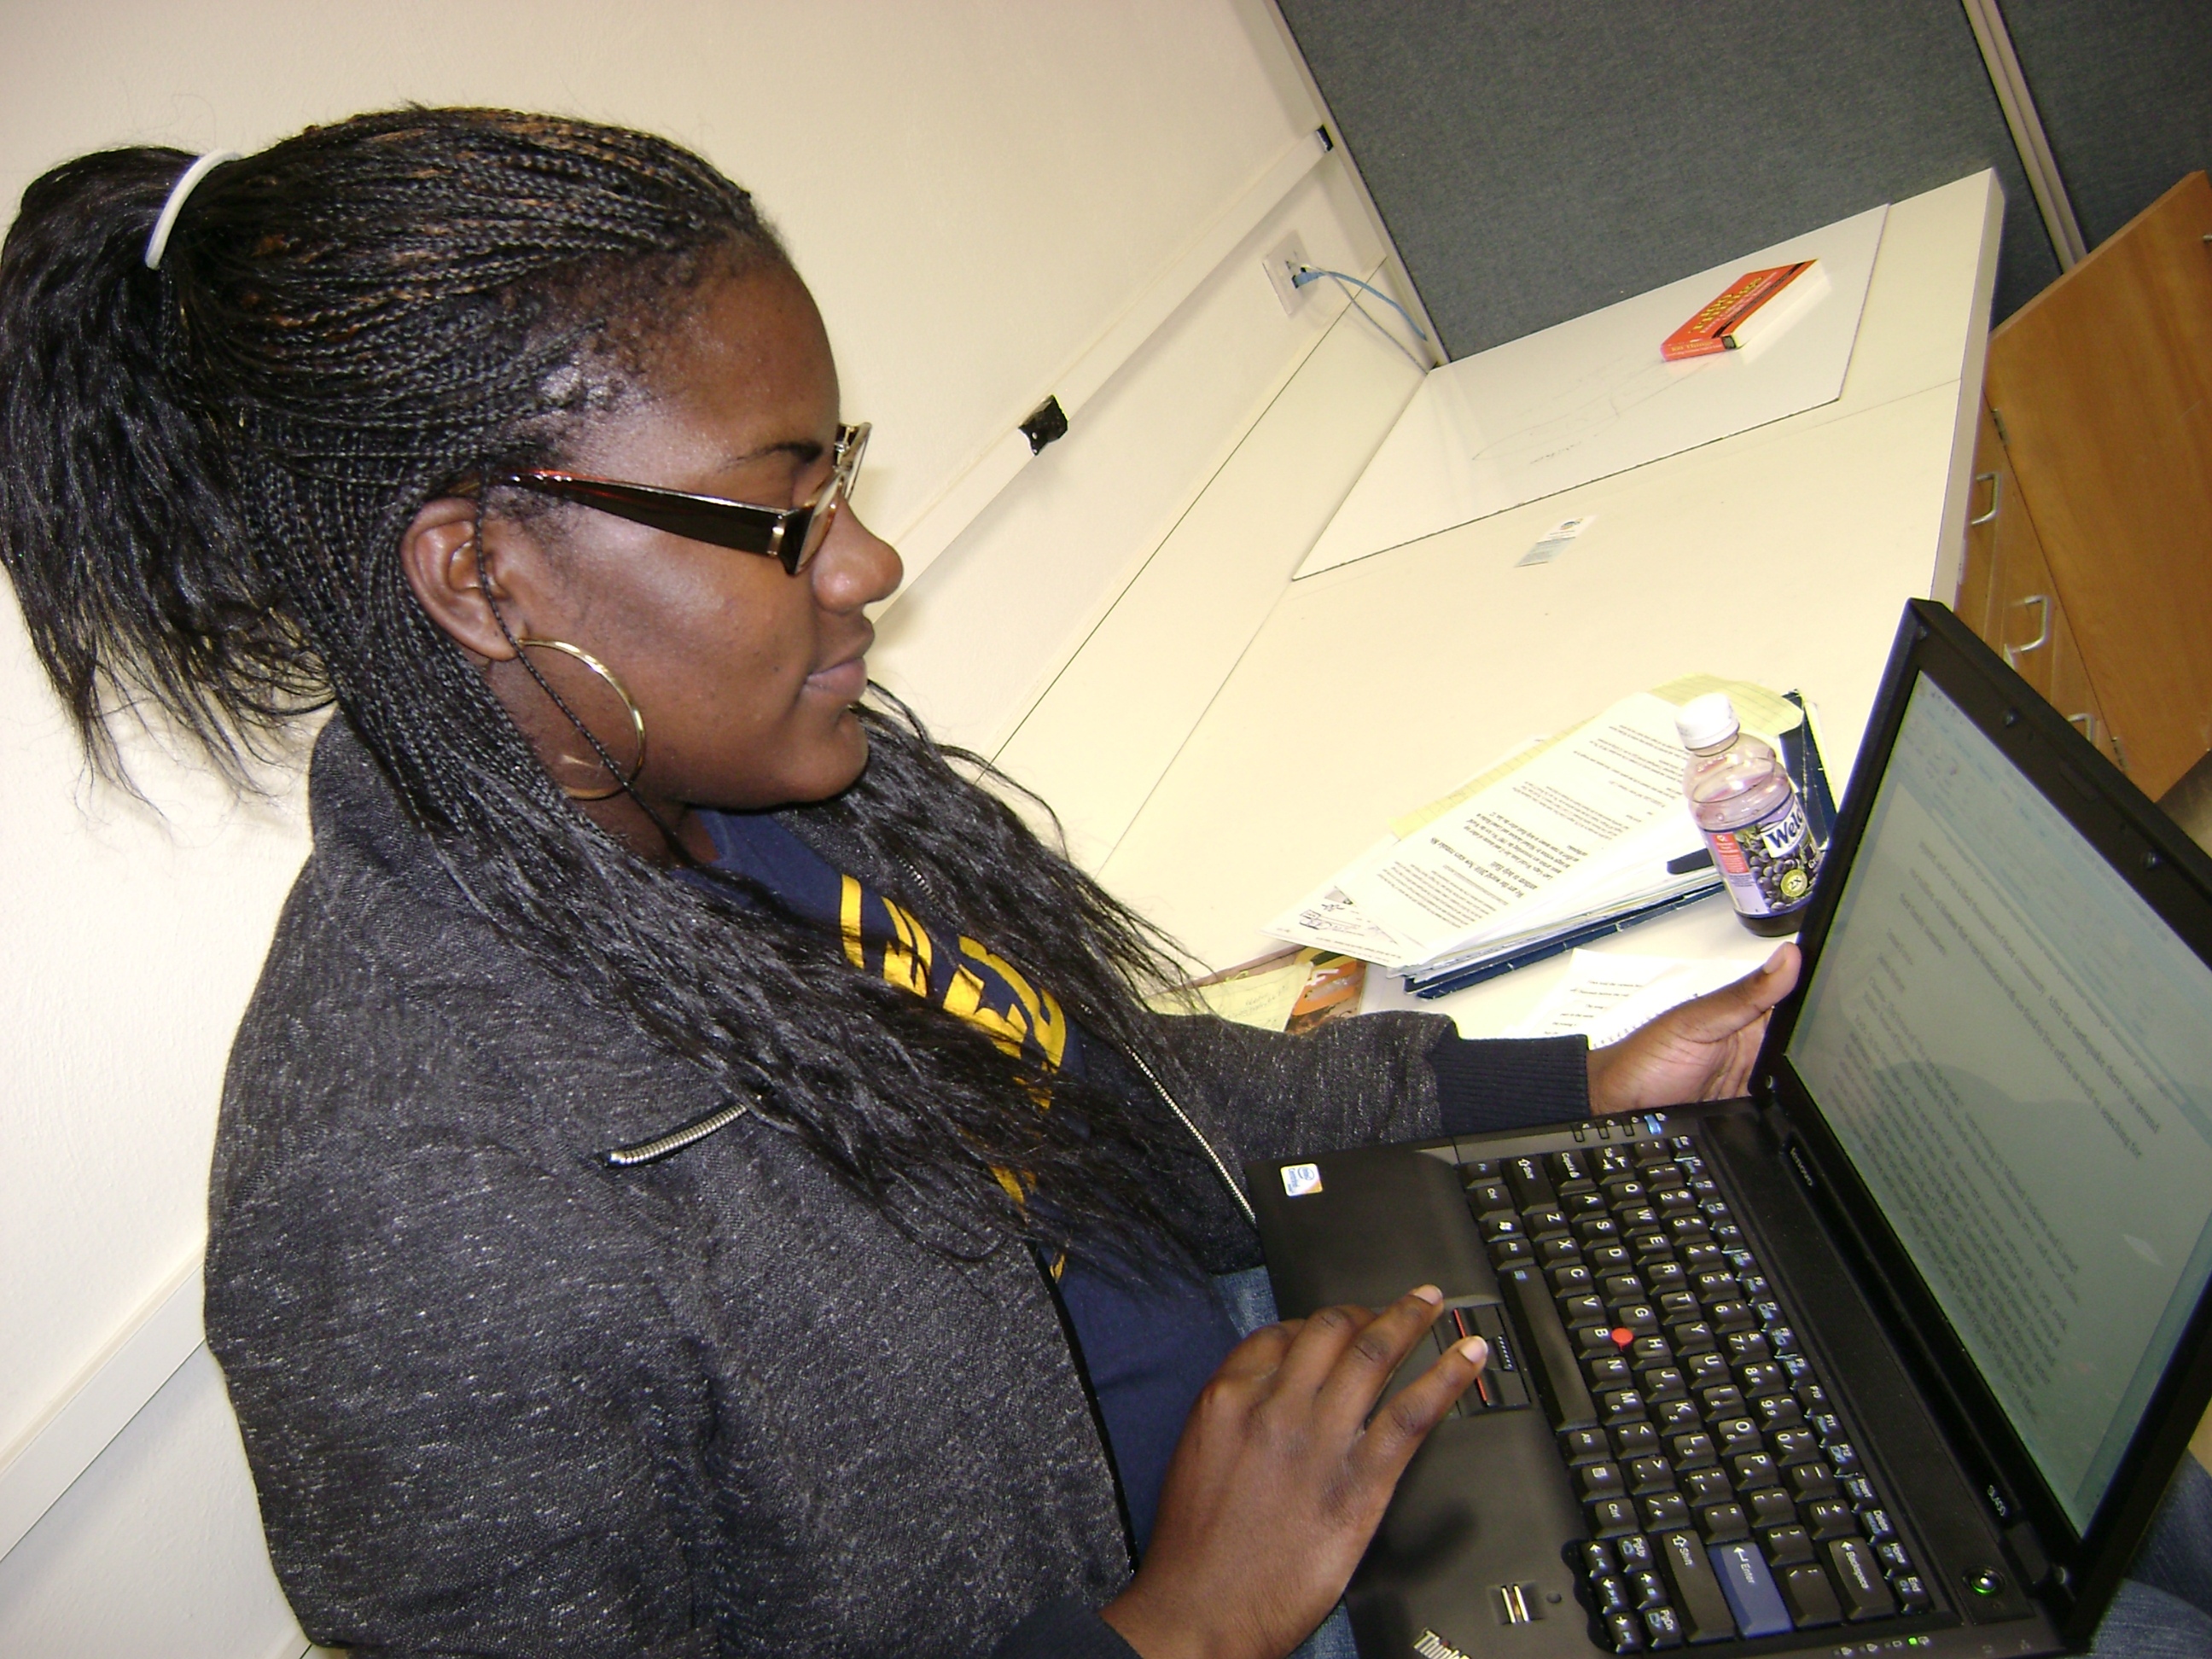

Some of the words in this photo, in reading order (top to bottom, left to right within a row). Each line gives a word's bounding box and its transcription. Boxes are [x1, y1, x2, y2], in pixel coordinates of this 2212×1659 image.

[2129, 1142, 2142, 1158] for
[1691, 1158, 1702, 1167] F1
[1624, 1182, 1639, 1193] Q
[1703, 1179, 1713, 1188] F2
[1486, 1186, 1498, 1199] Ctrl
[1659, 1192, 1674, 1201] 2
[1583, 1195, 1598, 1204] A
[1714, 1202, 1725, 1211] F3
[2004, 1164, 2026, 1199] Michael
[2024, 1202, 2047, 1231] Jackson
[2046, 1231, 2059, 1248] and
[1545, 1212, 1561, 1222] Z
[1636, 1208, 1653, 1220] W
[1595, 1220, 1610, 1230] S
[1673, 1219, 1686, 1227] 3
[1726, 1225, 1737, 1234] F4
[1557, 1239, 1573, 1249] X
[1648, 1235, 1664, 1245] E
[1507, 1241, 1518, 1251] Alt
[1687, 1246, 1700, 1254] 4
[1607, 1247, 1622, 1258] D
[1569, 1267, 1585, 1278] C
[1661, 1263, 1677, 1274] R
[1620, 1276, 1636, 1285] F
[1701, 1275, 1715, 1284] 5
[1753, 1275, 1764, 1286] F6
[1581, 1296, 1598, 1307] V
[1675, 1292, 1691, 1302] T
[1714, 1304, 1729, 1313] 6
[1766, 1301, 1778, 1311] F7
[1633, 1307, 1650, 1318] G
[1593, 1327, 1609, 1337] B
[1690, 1323, 1705, 1333] Y
[1779, 1326, 1790, 1337] F8
[1646, 1337, 1663, 1348] H
[1729, 1334, 1744, 1343] 7
[1606, 1359, 1623, 1370] N
[1703, 1354, 1720, 1365] U
[1794, 1357, 1806, 1368] F9
[1659, 1370, 1676, 1379] J
[1743, 1366, 1759, 1376] 8
[1808, 1384, 1822, 1399] F10
[1619, 1391, 1637, 1404] M
[1674, 1401, 1691, 1412] K
[1760, 1399, 1774, 1408] 9
[1823, 1413, 1837, 1427] F11
[1734, 1420, 1750, 1432] O
[1580, 1432, 1592, 1443] Alt
[1689, 1435, 1704, 1445] L
[1776, 1432, 1791, 1442] 0
[1838, 1443, 1853, 1457] F12
[1749, 1453, 1767, 1464] P
[1856, 1477, 1872, 1498] Insert
[1607, 1502, 1621, 1518] Ctrl
[1871, 1509, 1889, 1532] Delete
[1632, 1536, 1645, 1557] PgUp
[1889, 1541, 1906, 1563] Home
[1678, 1546, 1693, 1566] Shift
[1739, 1562, 1755, 1584] Enter
[1844, 1550, 1870, 1590] Backspace
[1906, 1575, 1921, 1592] End
[1659, 1609, 1674, 1631] PgDn
